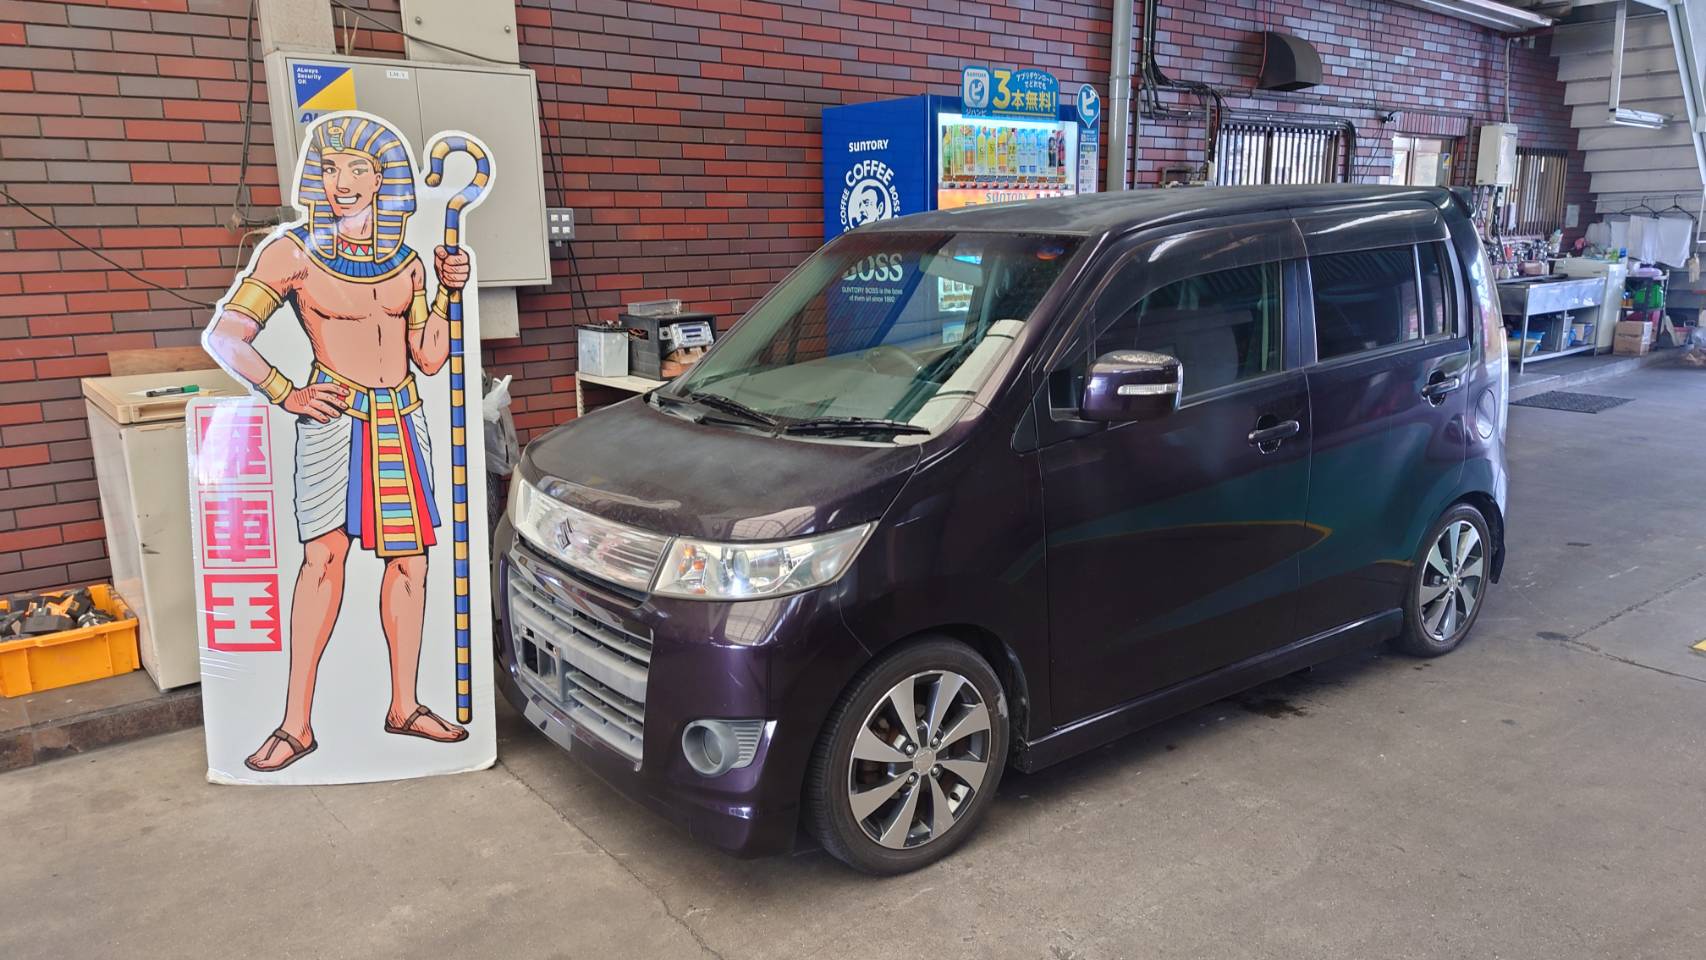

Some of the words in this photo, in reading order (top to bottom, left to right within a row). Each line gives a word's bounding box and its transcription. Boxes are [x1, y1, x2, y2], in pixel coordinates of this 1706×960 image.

[848, 139, 889, 152] SUNTORY
[845, 160, 895, 188] COFFEE
[840, 188, 850, 225] COFFEE
[889, 185, 901, 212] BOSS
